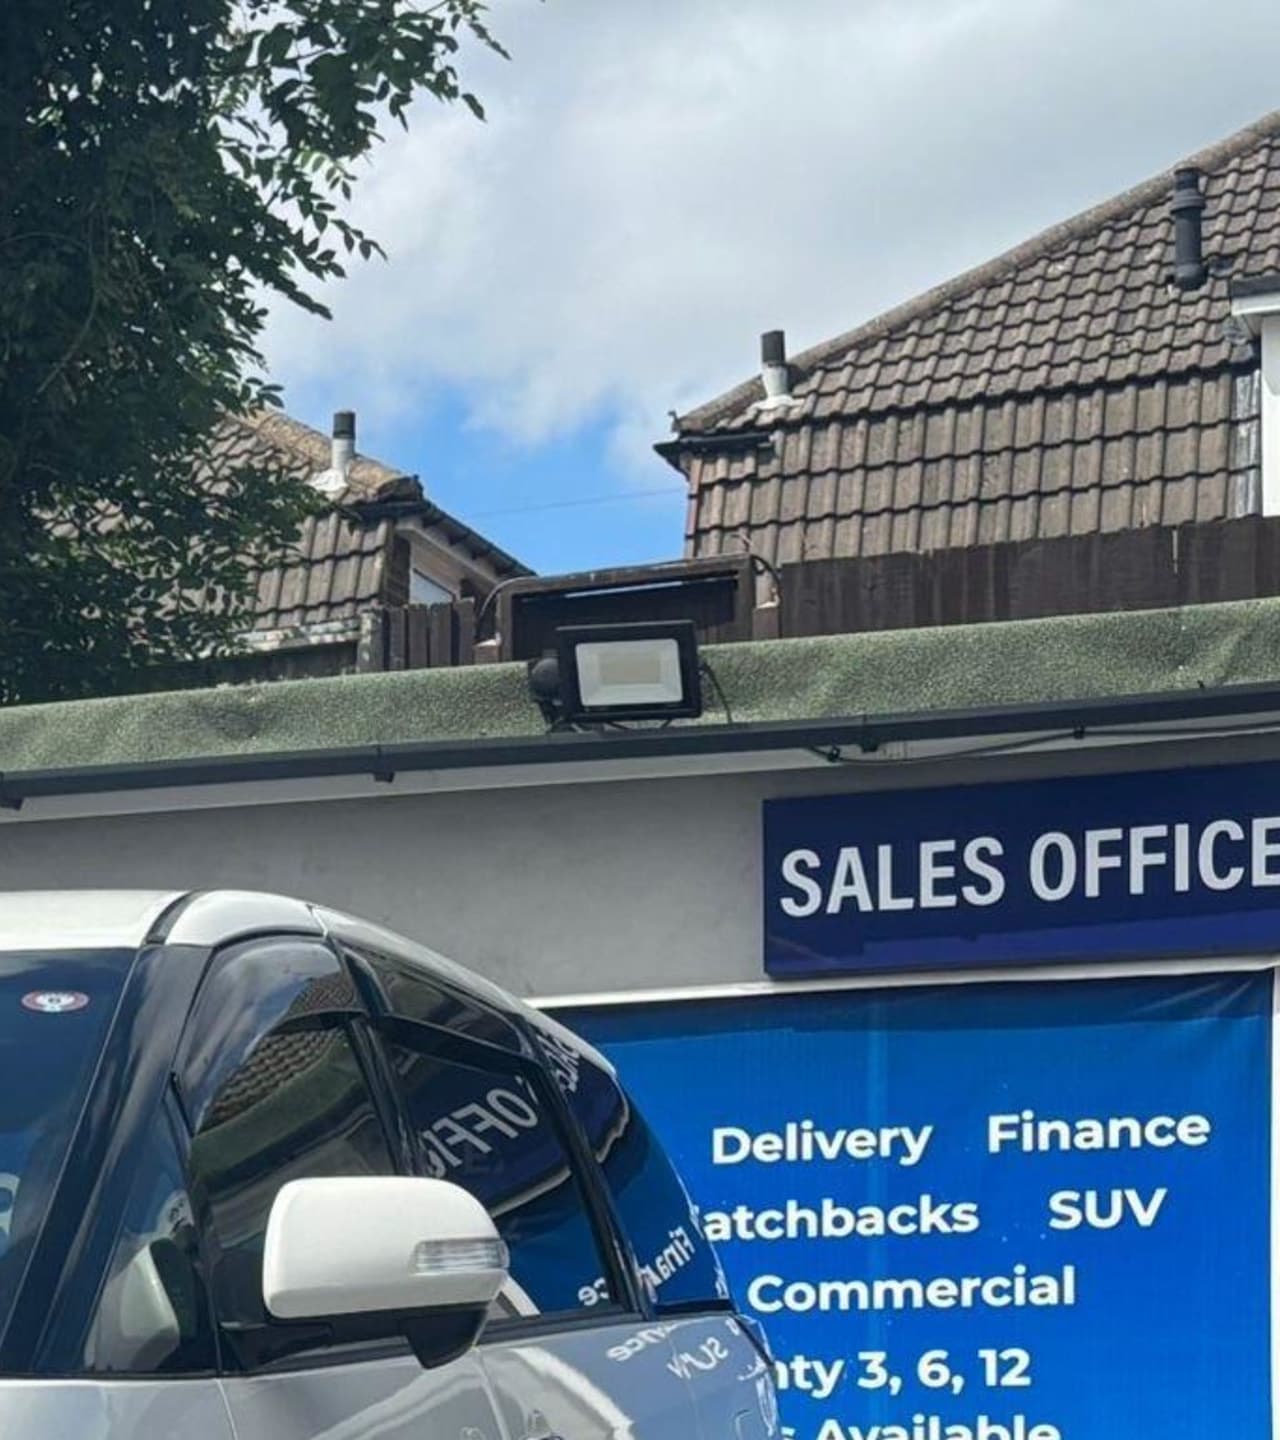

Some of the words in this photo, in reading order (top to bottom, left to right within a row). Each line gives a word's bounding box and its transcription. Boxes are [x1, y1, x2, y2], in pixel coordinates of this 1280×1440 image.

[780, 836, 1006, 917] SALES
[1029, 816, 1280, 902] OFFICE
[712, 1119, 934, 1167] Delivery
[987, 1109, 1212, 1154] Finance
[702, 1194, 981, 1242] atchbacks
[1048, 1188, 1167, 1230] SUV
[746, 1263, 1076, 1314] Commercial
[775, 1355, 845, 1400] nty
[856, 1350, 903, 1396] 3,
[916, 1348, 965, 1395] 6,
[978, 1347, 1032, 1387] 12
